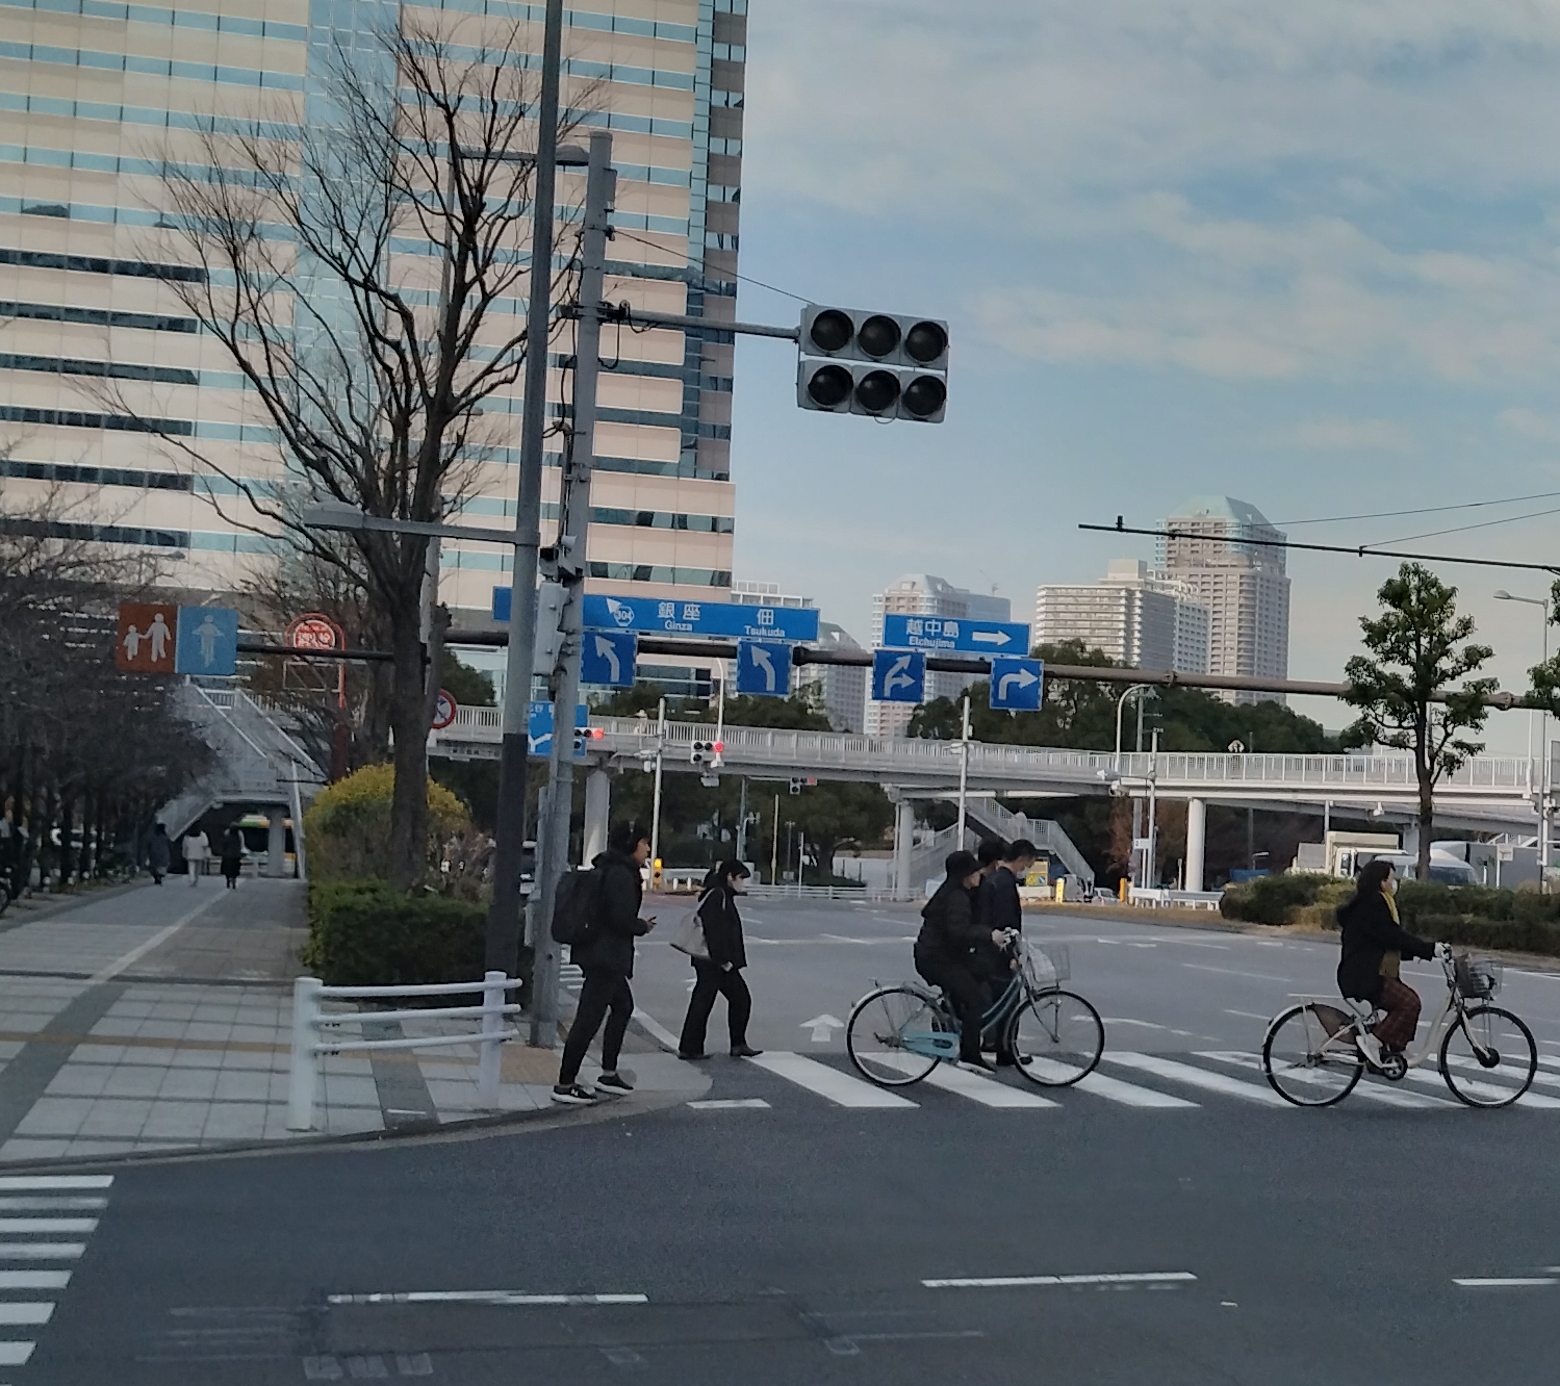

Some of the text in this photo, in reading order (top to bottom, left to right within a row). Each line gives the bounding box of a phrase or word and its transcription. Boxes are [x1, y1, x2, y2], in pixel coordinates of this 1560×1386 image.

[657, 601, 701, 620] 銀座
[756, 608, 774, 625] 佃
[664, 619, 692, 632] Ginza
[744, 625, 785, 637] Tsukuda
[906, 618, 959, 638] 越中島
